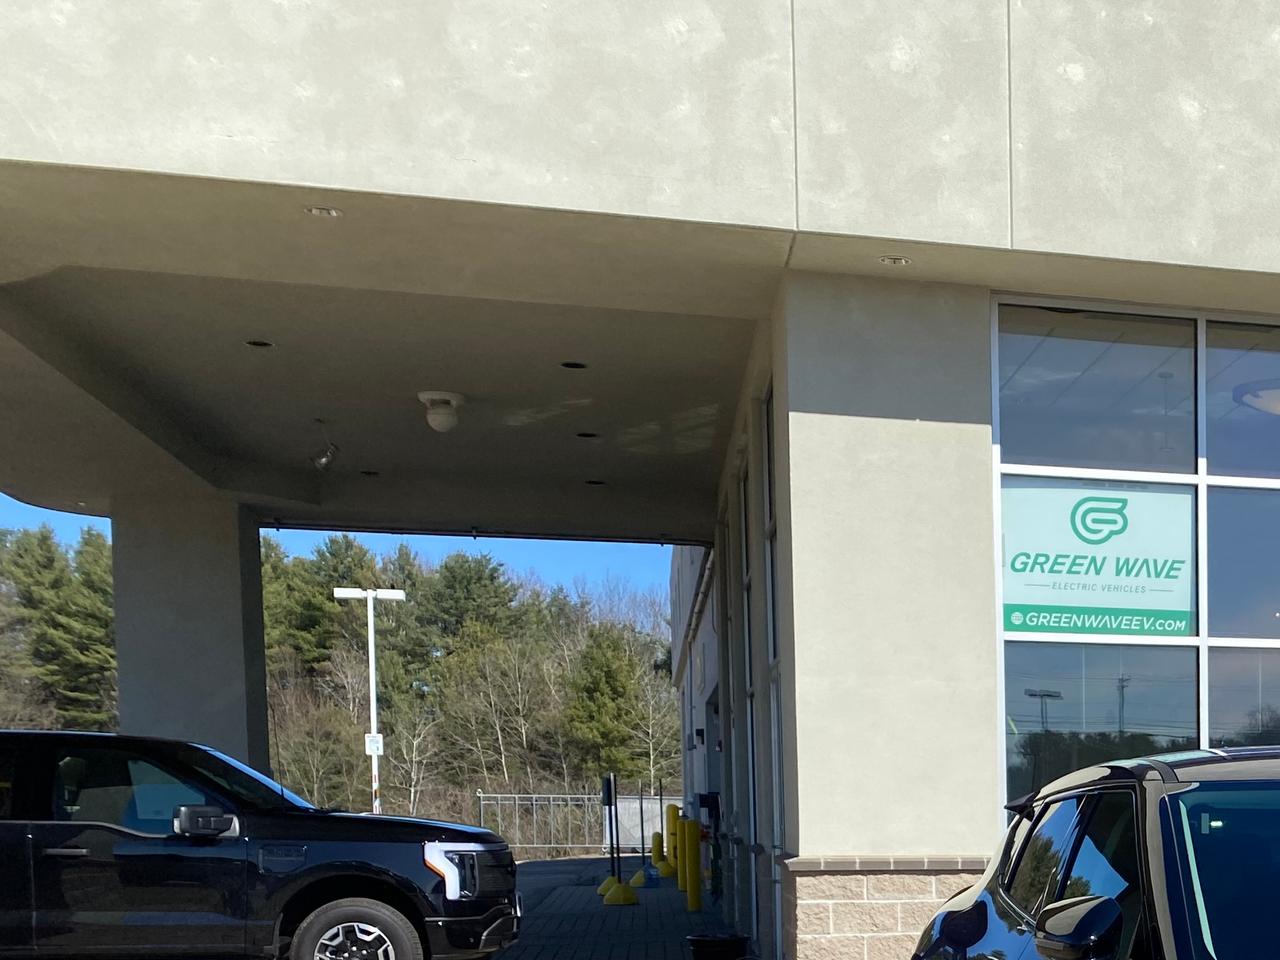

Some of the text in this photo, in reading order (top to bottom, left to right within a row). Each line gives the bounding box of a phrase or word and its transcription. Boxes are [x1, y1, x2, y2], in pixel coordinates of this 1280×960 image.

[1010, 552, 1185, 579] GREEN WAVE
[1052, 581, 1147, 594] ELECTRIC VEHICLES
